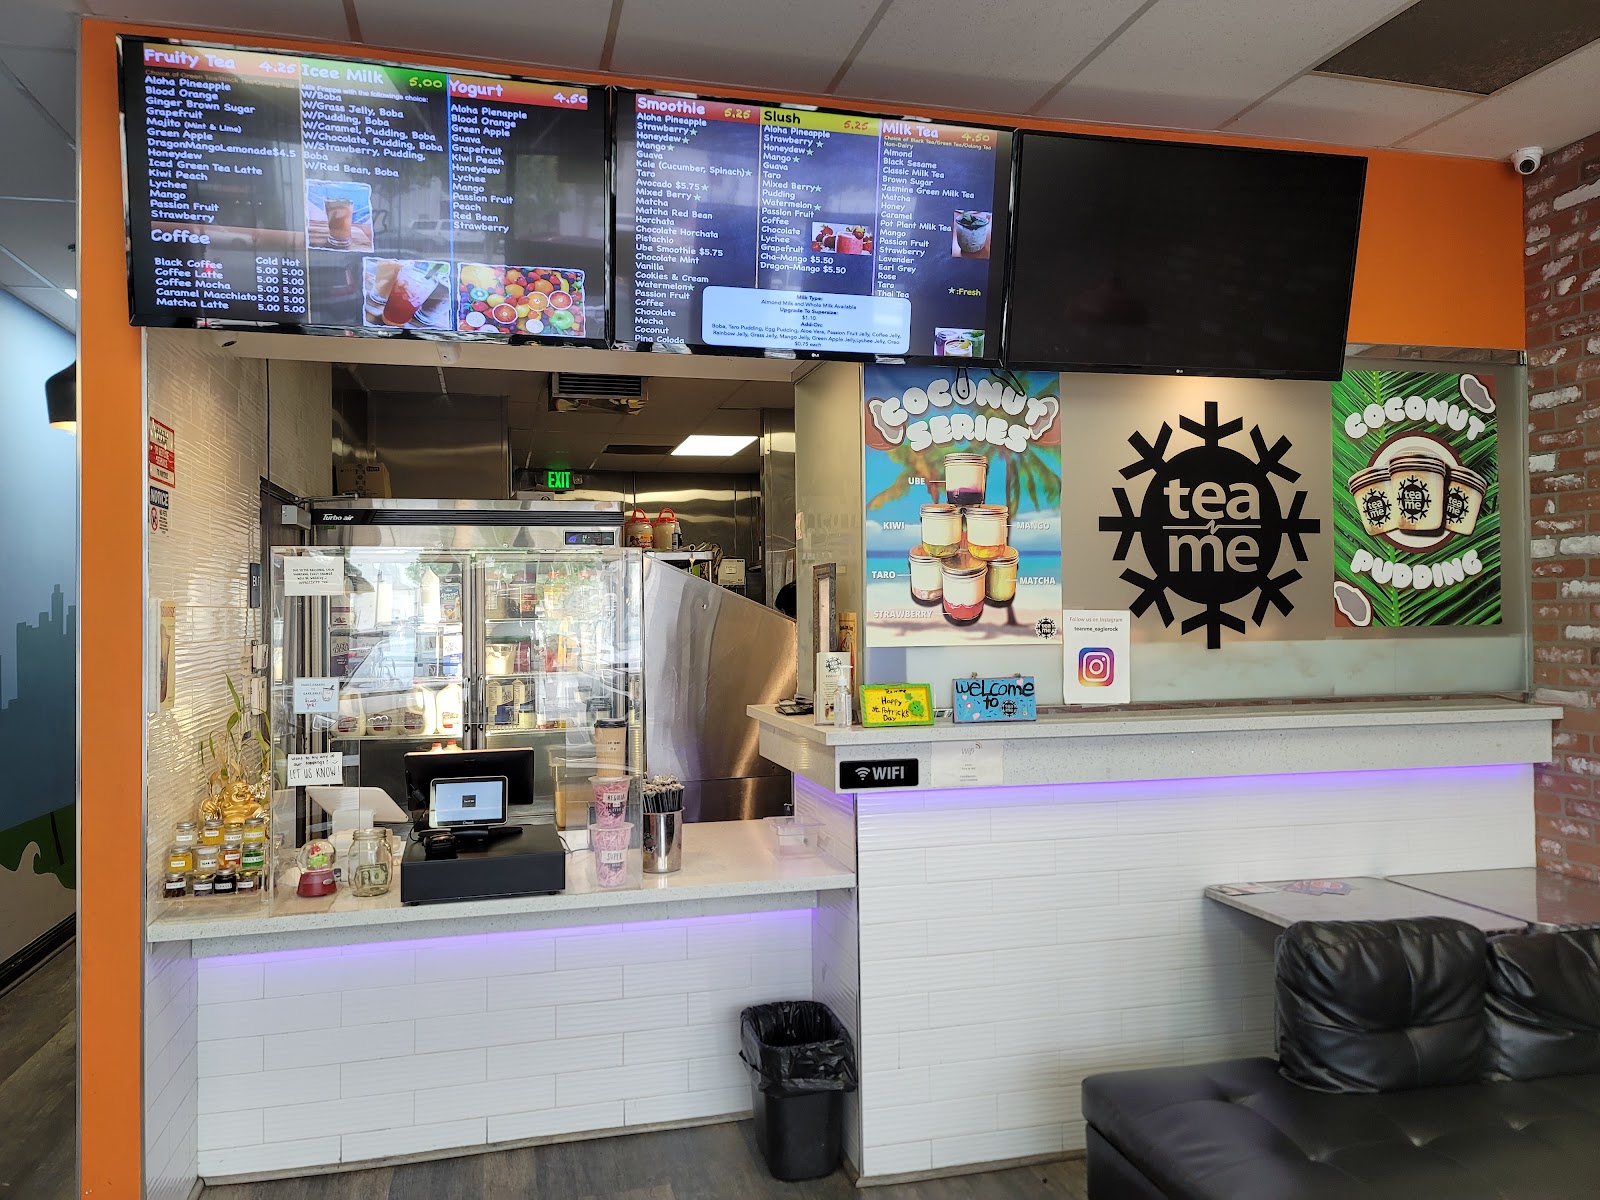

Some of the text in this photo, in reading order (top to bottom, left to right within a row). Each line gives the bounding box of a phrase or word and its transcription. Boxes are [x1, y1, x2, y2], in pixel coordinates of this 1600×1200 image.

[144, 49, 235, 69] Fruity Tea
[302, 63, 339, 80] Icee
[347, 68, 383, 85] Milk
[145, 75, 175, 86] Aloha
[179, 78, 231, 92] Pineapple
[409, 78, 442, 89] 5.00
[449, 80, 503, 98] Yogurt
[302, 90, 342, 102] W/Boba
[302, 101, 404, 118] W/Grass Jelly, Boba
[451, 104, 478, 114] Aloha
[637, 97, 705, 115] Smoothie
[147, 117, 181, 128] Mojito
[451, 114, 516, 128] Blood Orange
[637, 112, 707, 127] Aloha Pineapple
[764, 111, 800, 124] Slush
[303, 121, 436, 141] W/Caramel, Pudding, Boba
[882, 122, 939, 138] Milk Tea
[451, 134, 481, 144] Guava
[636, 141, 666, 152] Mango
[883, 148, 913, 158] Almond
[148, 148, 202, 160] Honeydew
[148, 158, 262, 175] Iced Green Tea Latte
[304, 162, 398, 177] W/Red Bean, Boba
[636, 160, 745, 177] Kale (Cucumber, Spinach)
[636, 169, 656, 178] Taro
[636, 178, 700, 191] Avocado $5.75
[882, 175, 933, 188] Brown Sugar
[636, 188, 692, 201] Mixed Berry
[882, 184, 975, 200] Jasmine Green Milk Tea
[762, 199, 812, 209] Watermelon
[881, 202, 906, 212] Honey
[454, 221, 509, 234] Strawberry
[635, 225, 718, 238] Chocolate Horchata
[880, 219, 952, 232] Pot Plant Milk Tea
[151, 229, 210, 244] Coffee
[635, 234, 674, 245] Pistachio
[635, 243, 724, 257] Ube Smoothie $5.75
[154, 257, 223, 270] Black Coffee
[255, 256, 301, 267] Cold Hot
[761, 253, 834, 265] Cha-Mango $5.50
[878, 255, 915, 265] Lavender
[256, 266, 304, 277] 5.00 5.00
[761, 262, 847, 275] Dragon-Mango $5.50
[878, 263, 917, 275] Earl Grey
[635, 271, 669, 281] Cookies
[682, 274, 709, 283] Cream
[878, 272, 896, 281] Rose
[155, 277, 231, 290] Coffee Mocha
[877, 289, 909, 299] Thai Tea
[156, 297, 229, 310] Matcha Latte
[635, 316, 664, 326] Mocha
[635, 325, 670, 335] Coconut
[880, 378, 1048, 427] COCONUT
[1345, 396, 1485, 440] COCONUT
[906, 413, 1030, 453] SERIES
[548, 472, 570, 488] EXIT
[908, 477, 926, 485] UBE
[1164, 479, 1260, 520] tea
[1404, 489, 1422, 499] tea
[1368, 500, 1382, 510] tea
[1404, 500, 1422, 511] me
[1448, 495, 1462, 508] tea
[322, 513, 342, 521] Turbo
[1369, 508, 1385, 519] me
[1446, 506, 1460, 516] me
[883, 521, 905, 530] KIWI
[1016, 522, 1050, 530] MANGO
[1169, 534, 1260, 572] me
[871, 570, 896, 579] TARO
[1350, 549, 1482, 589] PUDDING
[1019, 576, 1056, 585] MATCHA
[873, 610, 933, 618] STRAWBERRY
[881, 697, 902, 706] Happy
[983, 695, 998, 709] to
[290, 769, 300, 779] LET
[303, 768, 313, 779] US
[872, 767, 904, 780] WIFI
